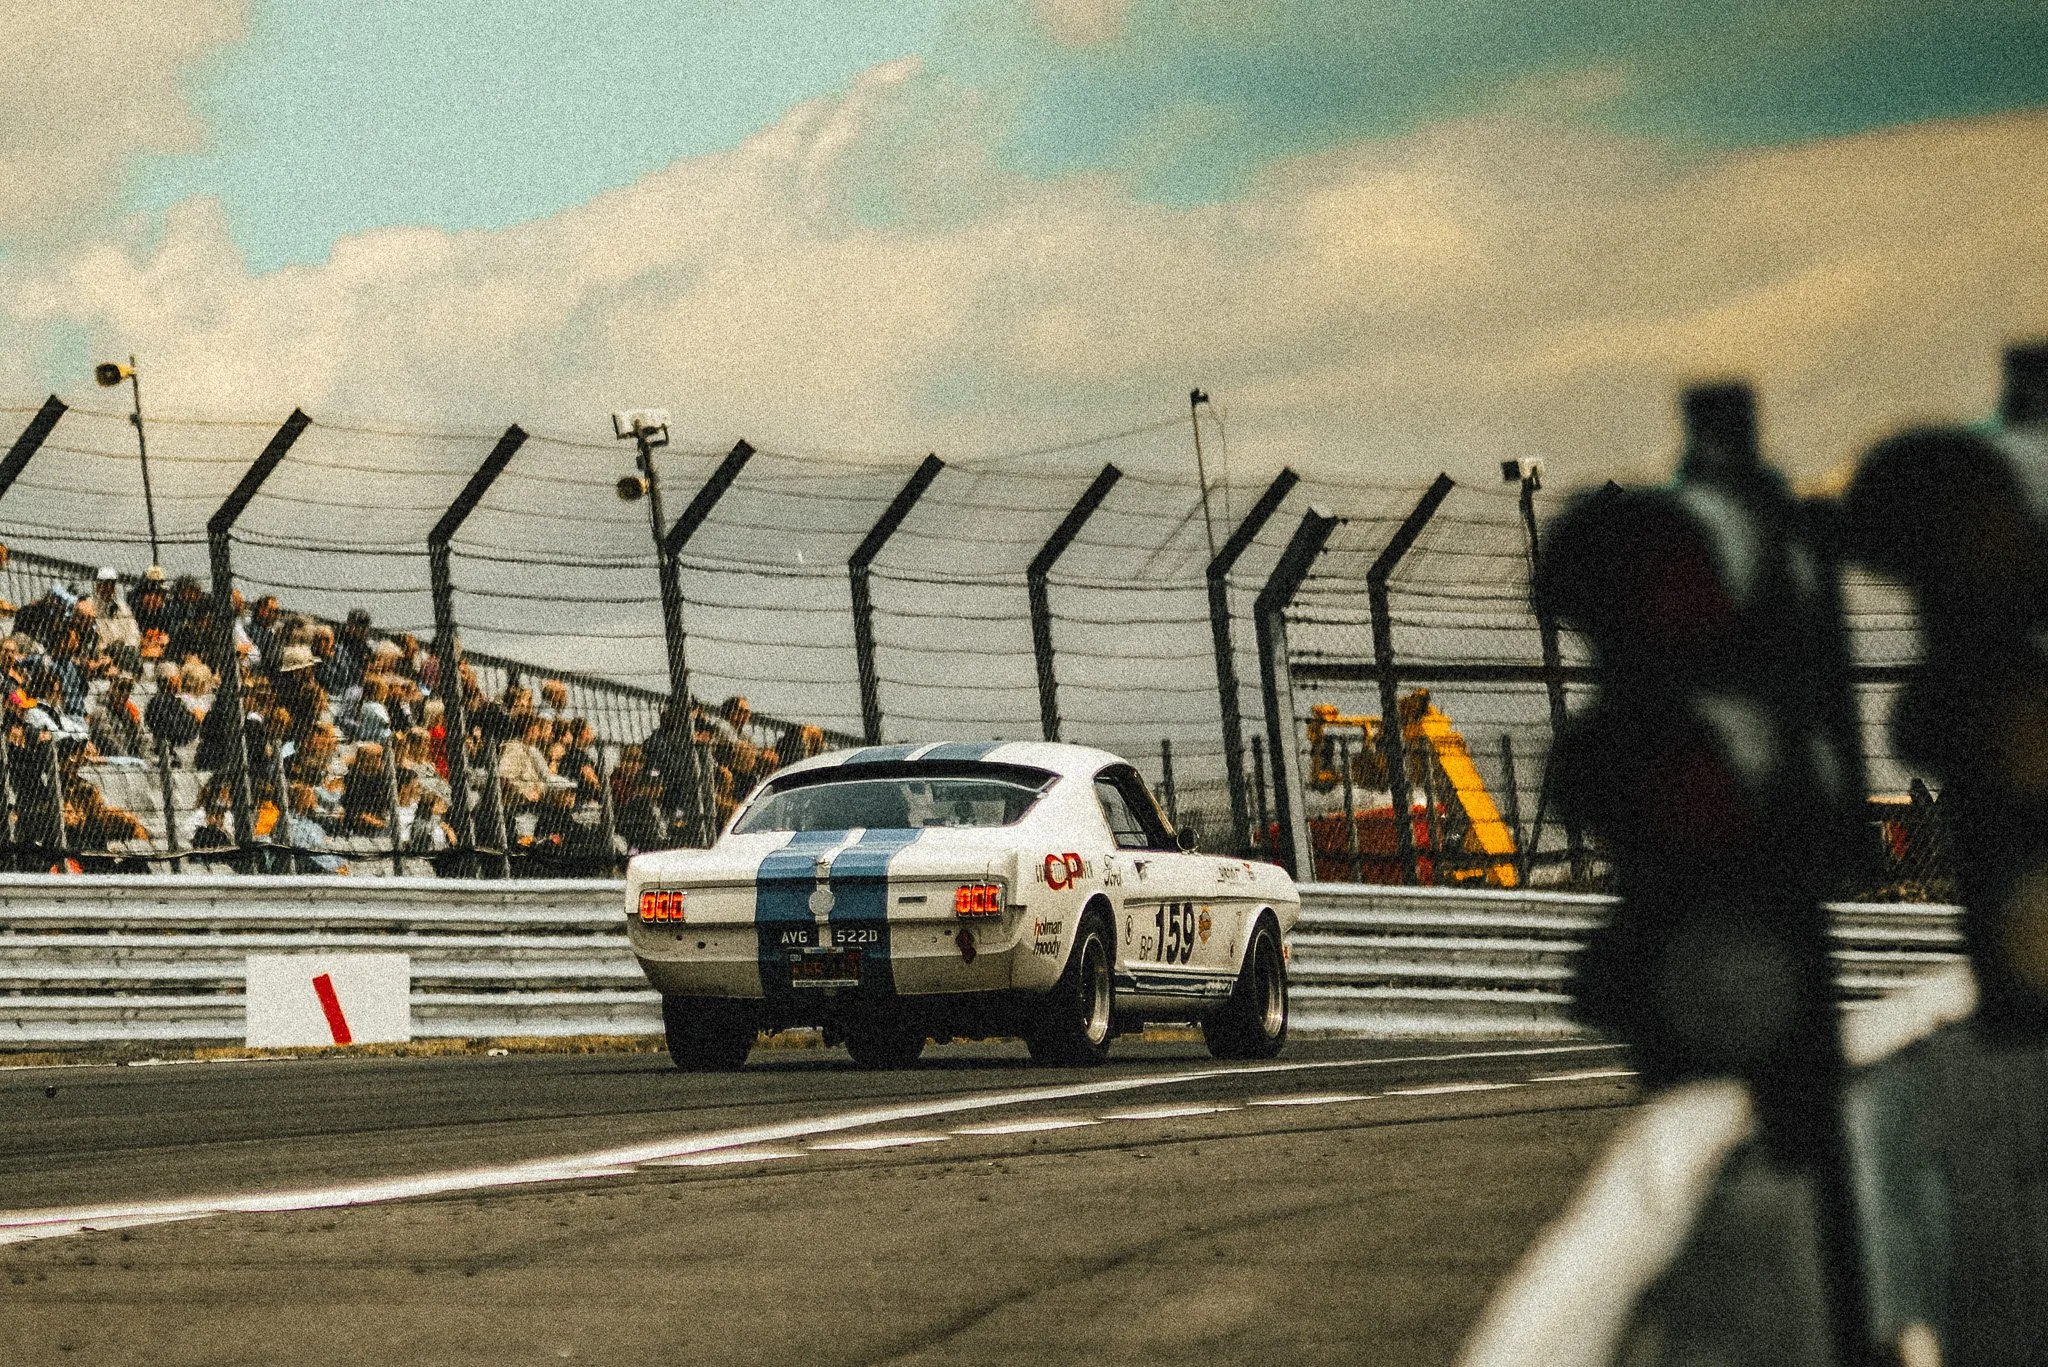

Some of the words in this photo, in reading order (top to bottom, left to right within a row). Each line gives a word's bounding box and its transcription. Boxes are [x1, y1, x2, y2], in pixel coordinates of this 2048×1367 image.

[781, 930, 808, 944] AVG
[837, 929, 878, 943] 522D
[1034, 917, 1062, 936] holman
[1156, 902, 1195, 964] 159
[1139, 935, 1153, 960] BP
